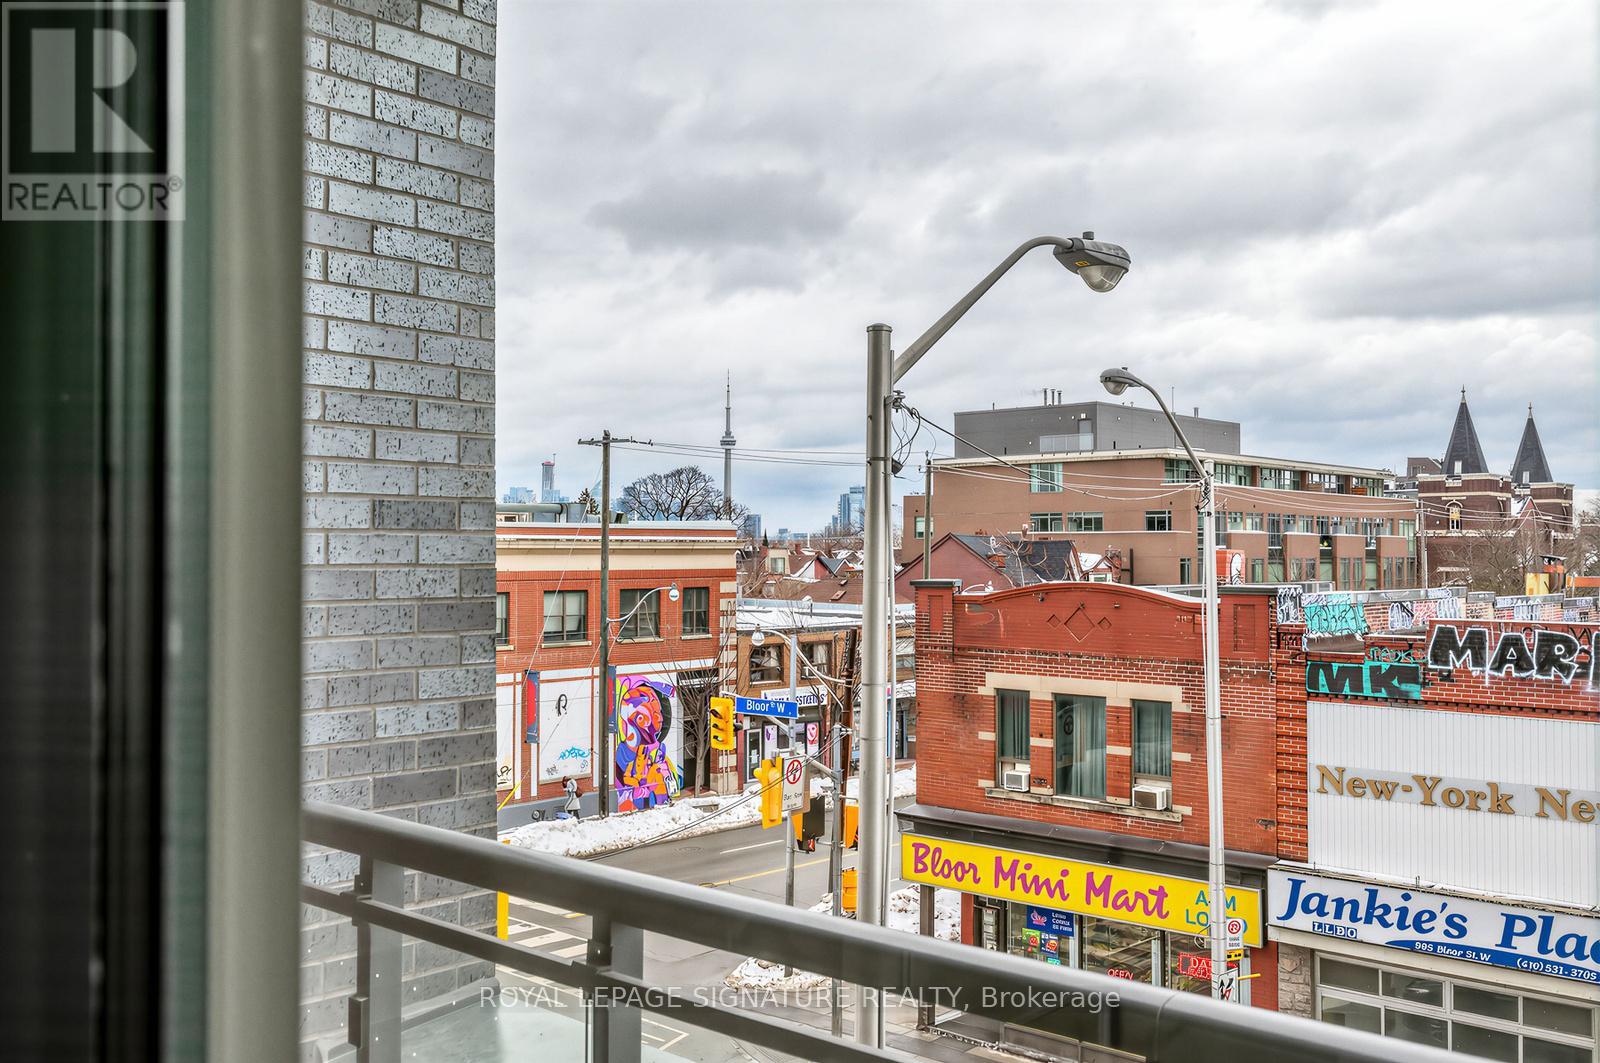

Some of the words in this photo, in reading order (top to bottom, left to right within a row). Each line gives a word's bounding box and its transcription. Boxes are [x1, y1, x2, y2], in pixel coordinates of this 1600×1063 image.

[746, 700, 769, 712] Bloor
[776, 703, 786, 713] W
[1316, 764, 1515, 815] New-York
[1535, 787, 1600, 823] Ne
[911, 842, 981, 884] Bloor
[994, 855, 1069, 902] Mini
[1085, 871, 1170, 920] Mart
[1276, 877, 1469, 939] Jankie's
[1480, 953, 1491, 961] W
